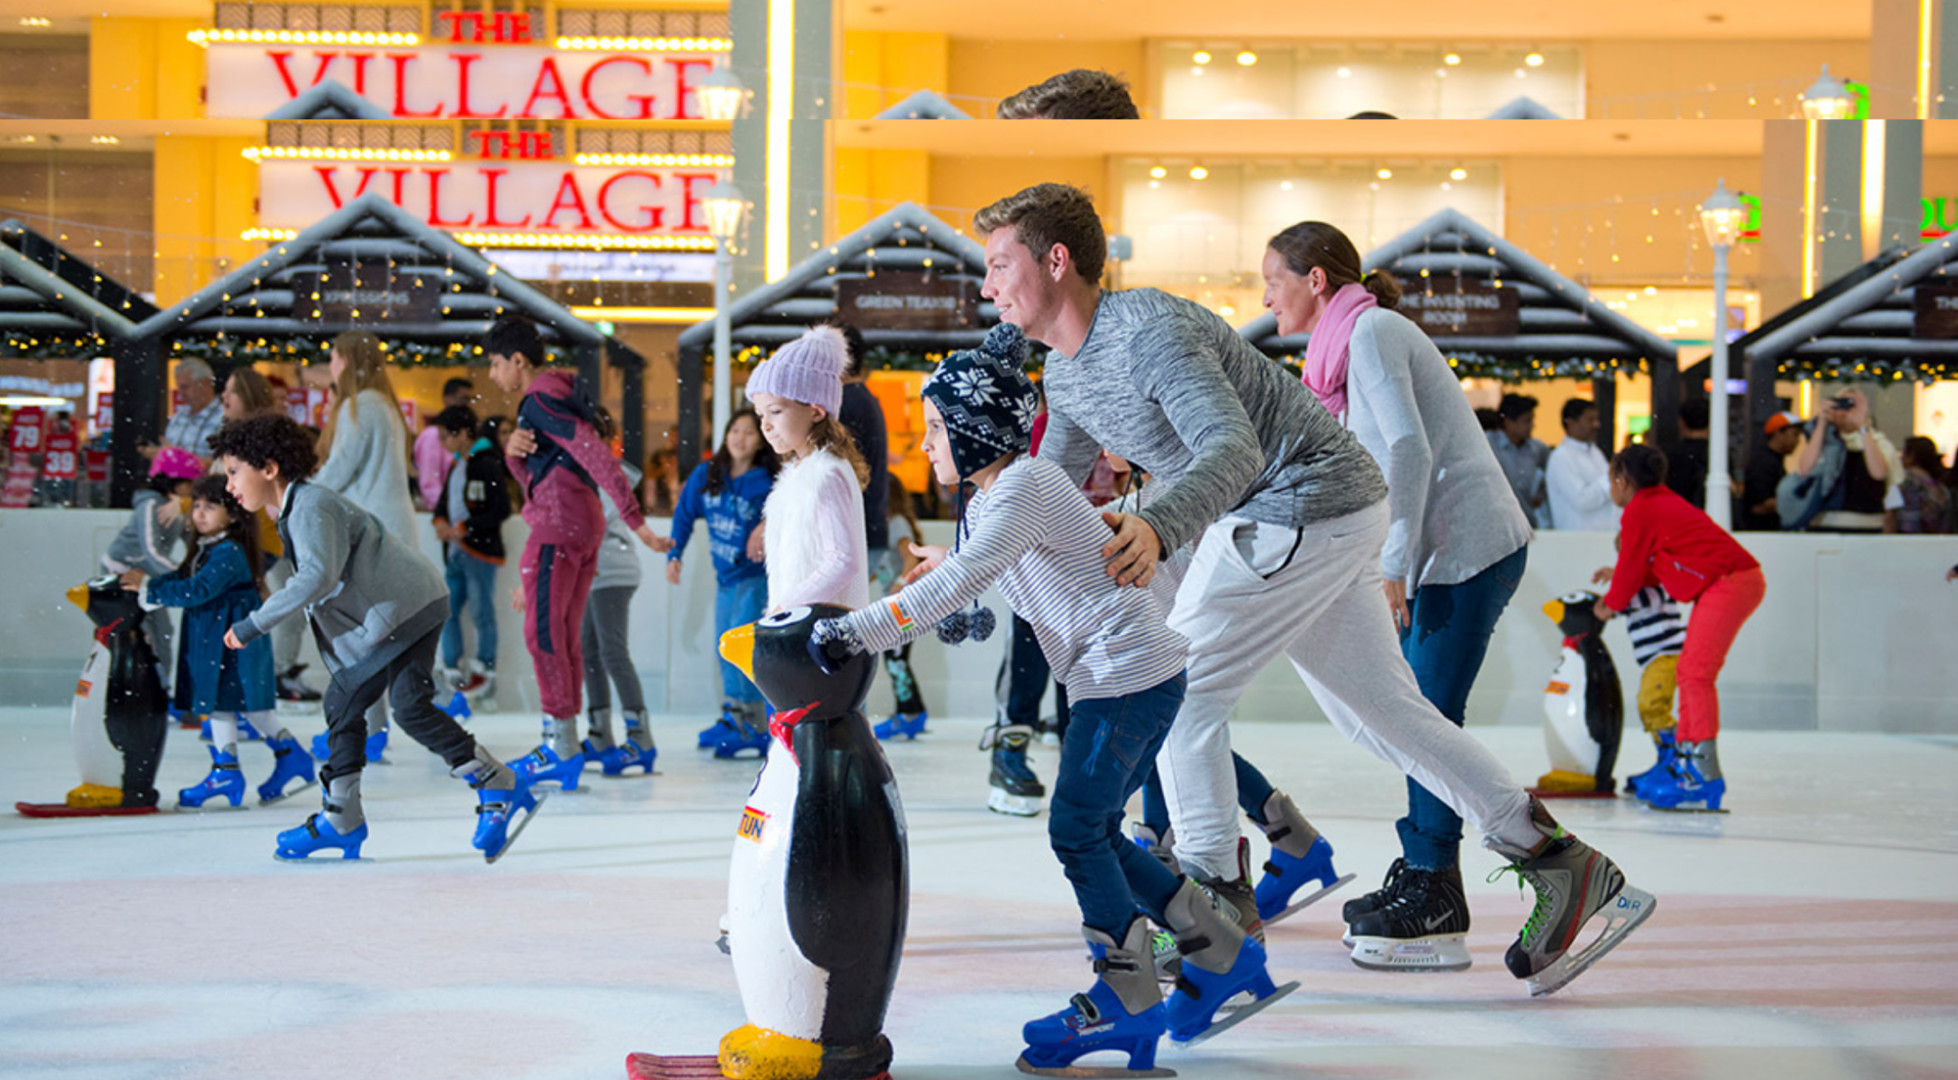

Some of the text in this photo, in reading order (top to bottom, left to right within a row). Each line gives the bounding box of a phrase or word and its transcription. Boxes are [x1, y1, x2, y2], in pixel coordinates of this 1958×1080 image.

[440, 11, 531, 43] THE
[266, 50, 714, 119] VILLAGE
[470, 131, 554, 159] THE
[313, 166, 718, 232] VILLAGE
[13, 425, 39, 448] 79
[46, 451, 74, 473] 39
